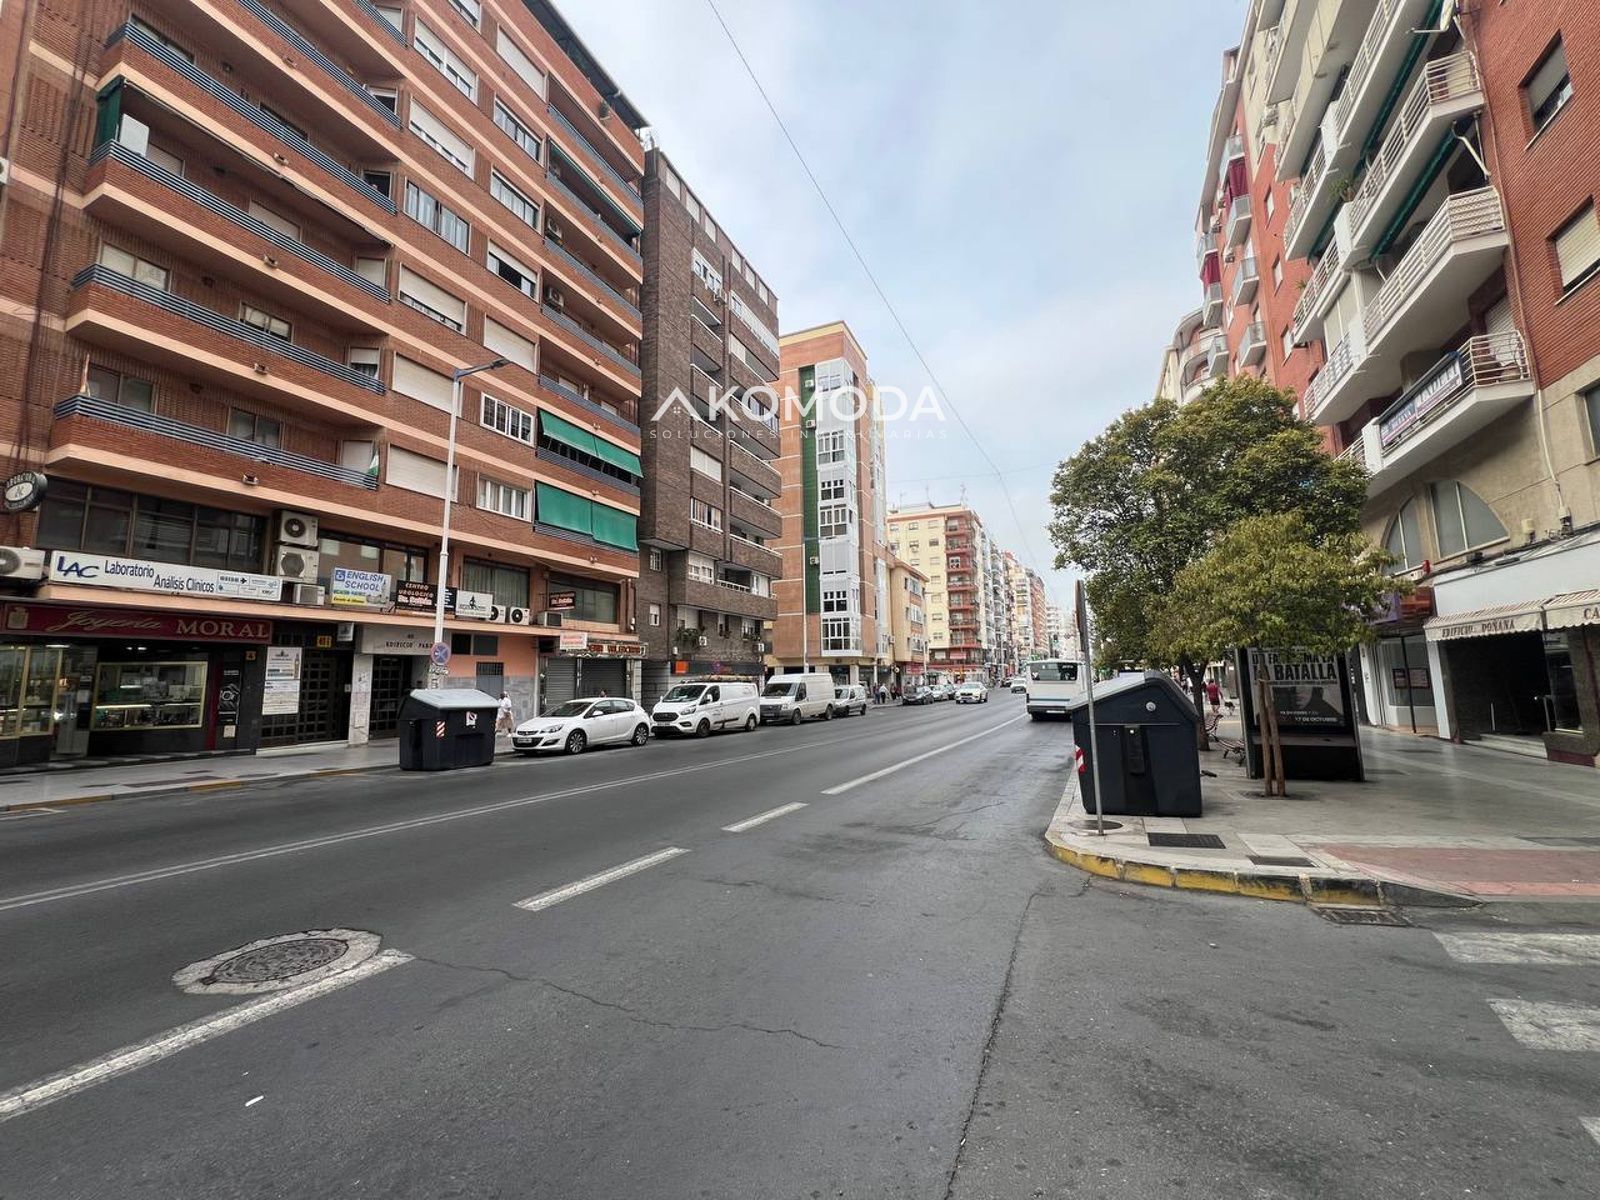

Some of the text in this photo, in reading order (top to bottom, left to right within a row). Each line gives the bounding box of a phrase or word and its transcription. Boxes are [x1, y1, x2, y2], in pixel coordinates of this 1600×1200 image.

[57, 556, 99, 578] LAC
[104, 559, 155, 578] Laboratorio
[346, 571, 384, 582] ENGLISH
[344, 580, 380, 592] SCHOOL
[176, 618, 269, 638] MORAL
[1273, 663, 1337, 681] BATALLA
